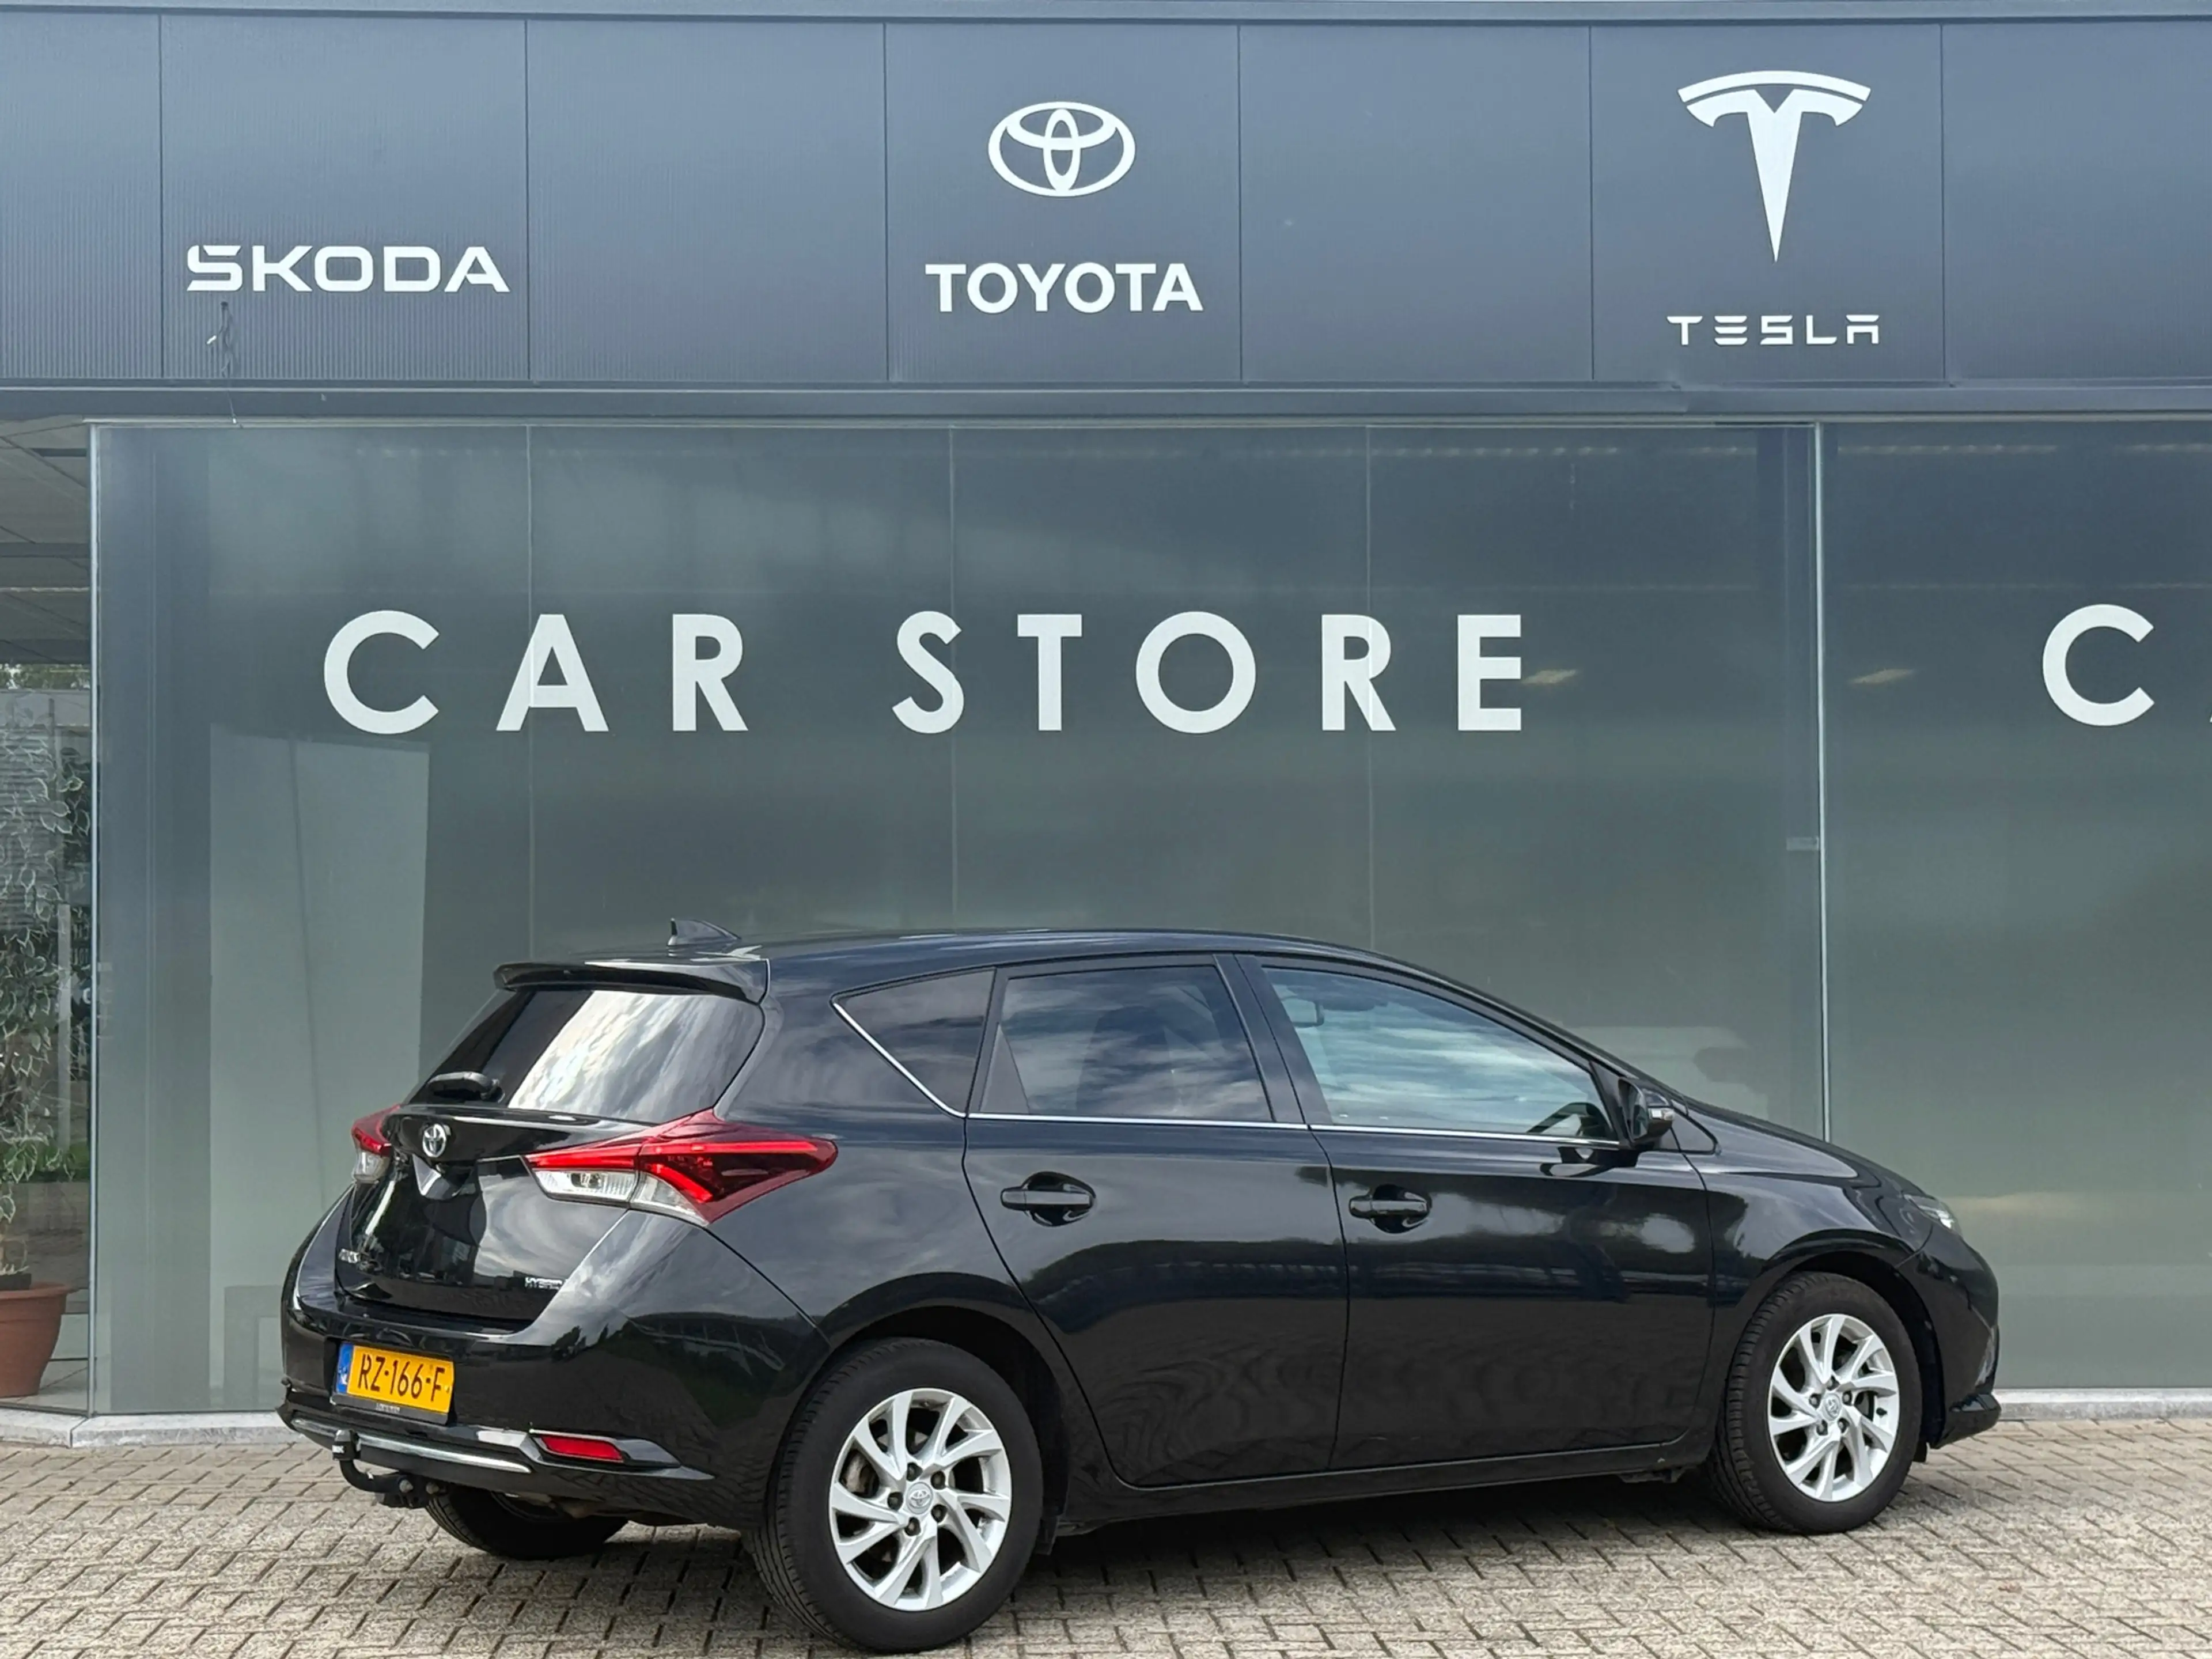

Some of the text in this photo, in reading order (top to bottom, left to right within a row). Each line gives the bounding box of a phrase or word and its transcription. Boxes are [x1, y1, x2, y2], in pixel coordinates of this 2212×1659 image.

[186, 245, 510, 293] SKODA
[925, 262, 1204, 313] TOYOTA
[1666, 315, 1880, 346] TESLA
[323, 610, 1522, 734] CAR STORE
[2042, 604, 2212, 726] C
[357, 1353, 446, 1403] RZ-166-F
